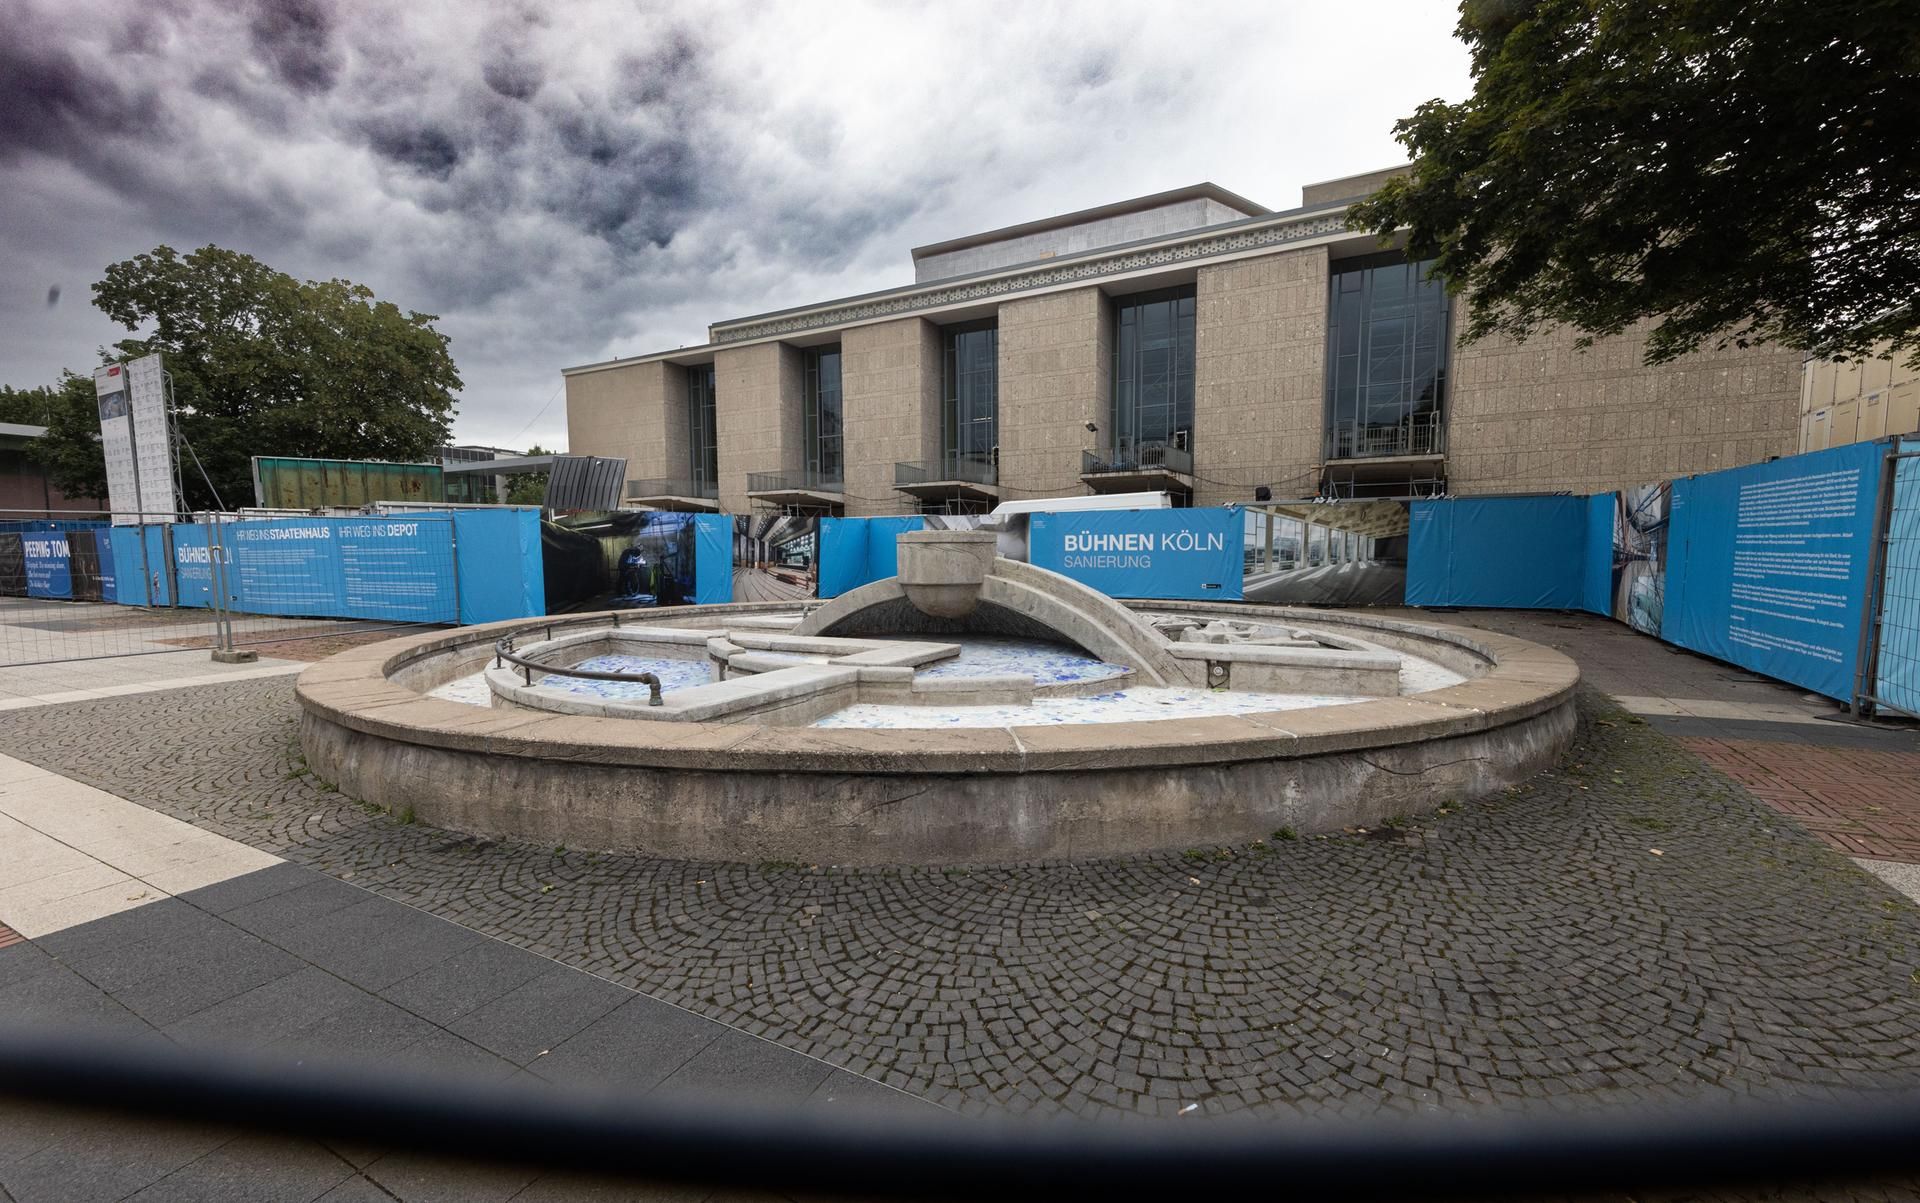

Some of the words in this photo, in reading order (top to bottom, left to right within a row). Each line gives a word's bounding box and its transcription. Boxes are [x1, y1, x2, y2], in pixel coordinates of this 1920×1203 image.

[270, 526, 330, 540] STAATENHAUS
[338, 526, 352, 538] IHR
[353, 525, 370, 537] WEG
[372, 524, 386, 537] INS
[387, 523, 418, 537] DEPOT
[1063, 530, 1154, 551] BÜHNEN
[1161, 529, 1224, 551] KÖLN
[24, 540, 51, 557] PEEPING
[51, 540, 71, 557] TOM
[178, 543, 211, 563] BÜHNEN
[1063, 555, 1151, 568] SANIERUNG
